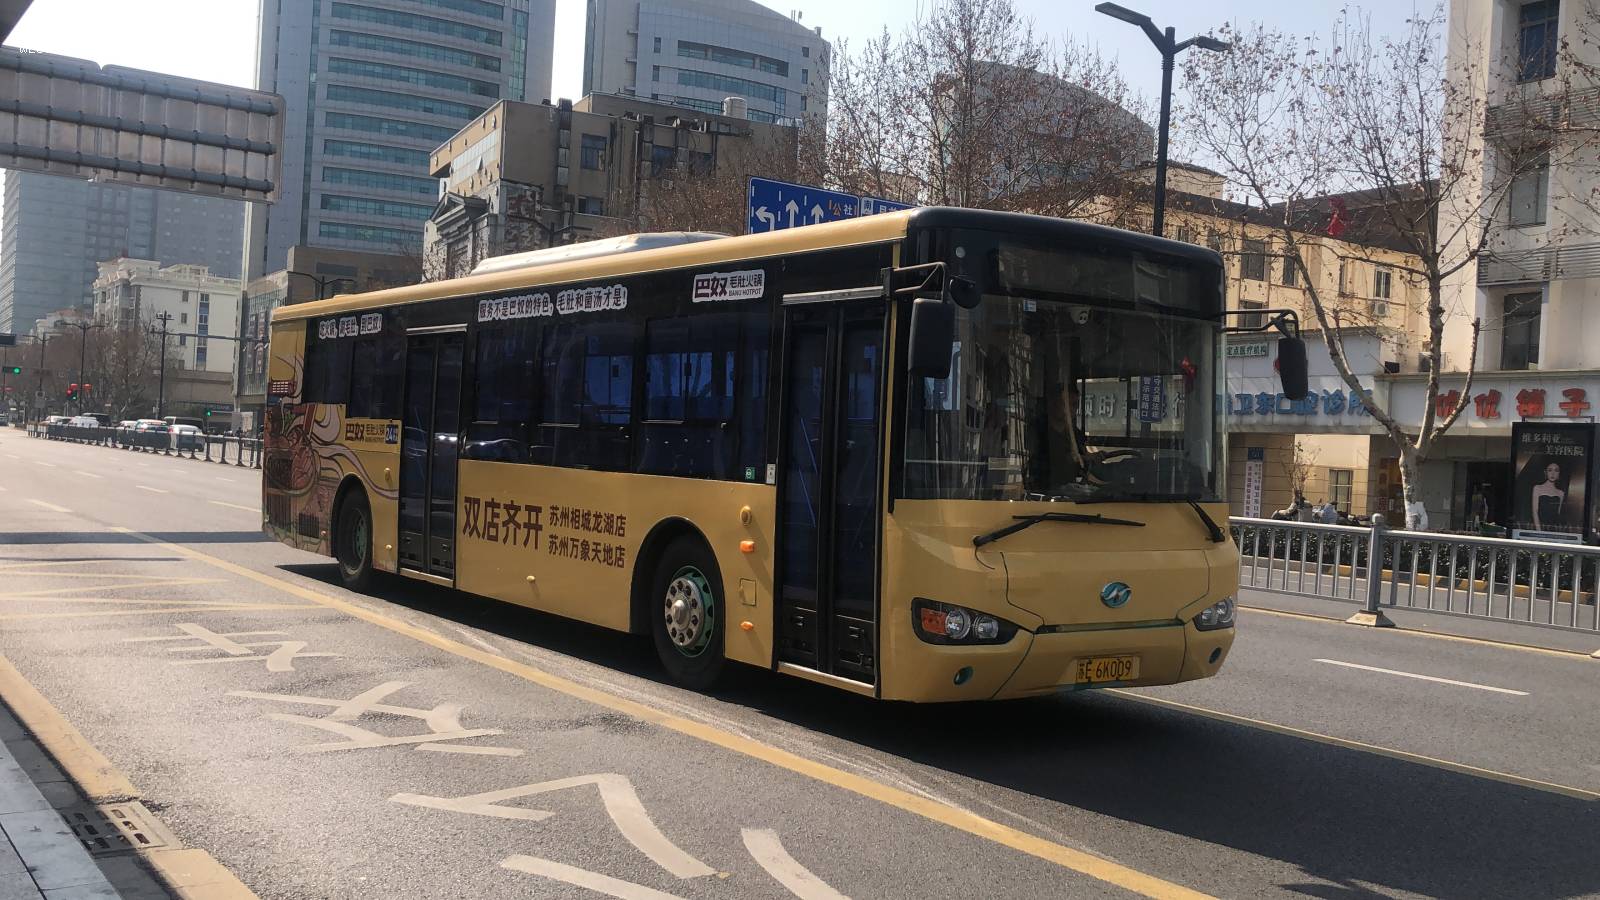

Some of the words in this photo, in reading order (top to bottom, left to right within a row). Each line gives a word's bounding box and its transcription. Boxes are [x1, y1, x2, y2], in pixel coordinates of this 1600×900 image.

[694, 276, 728, 298] 巴奴
[730, 273, 763, 288] 毛肚火锅
[743, 288, 762, 296] HOTPOT
[345, 422, 365, 441] 巴奴
[1522, 432, 1561, 444] 维多利亚
[1545, 445, 1584, 456] 美容医院
[462, 496, 543, 550] 双店齐开
[549, 505, 627, 537] 苏州相城龙湖店
[549, 534, 626, 568] 苏州万象天地店
